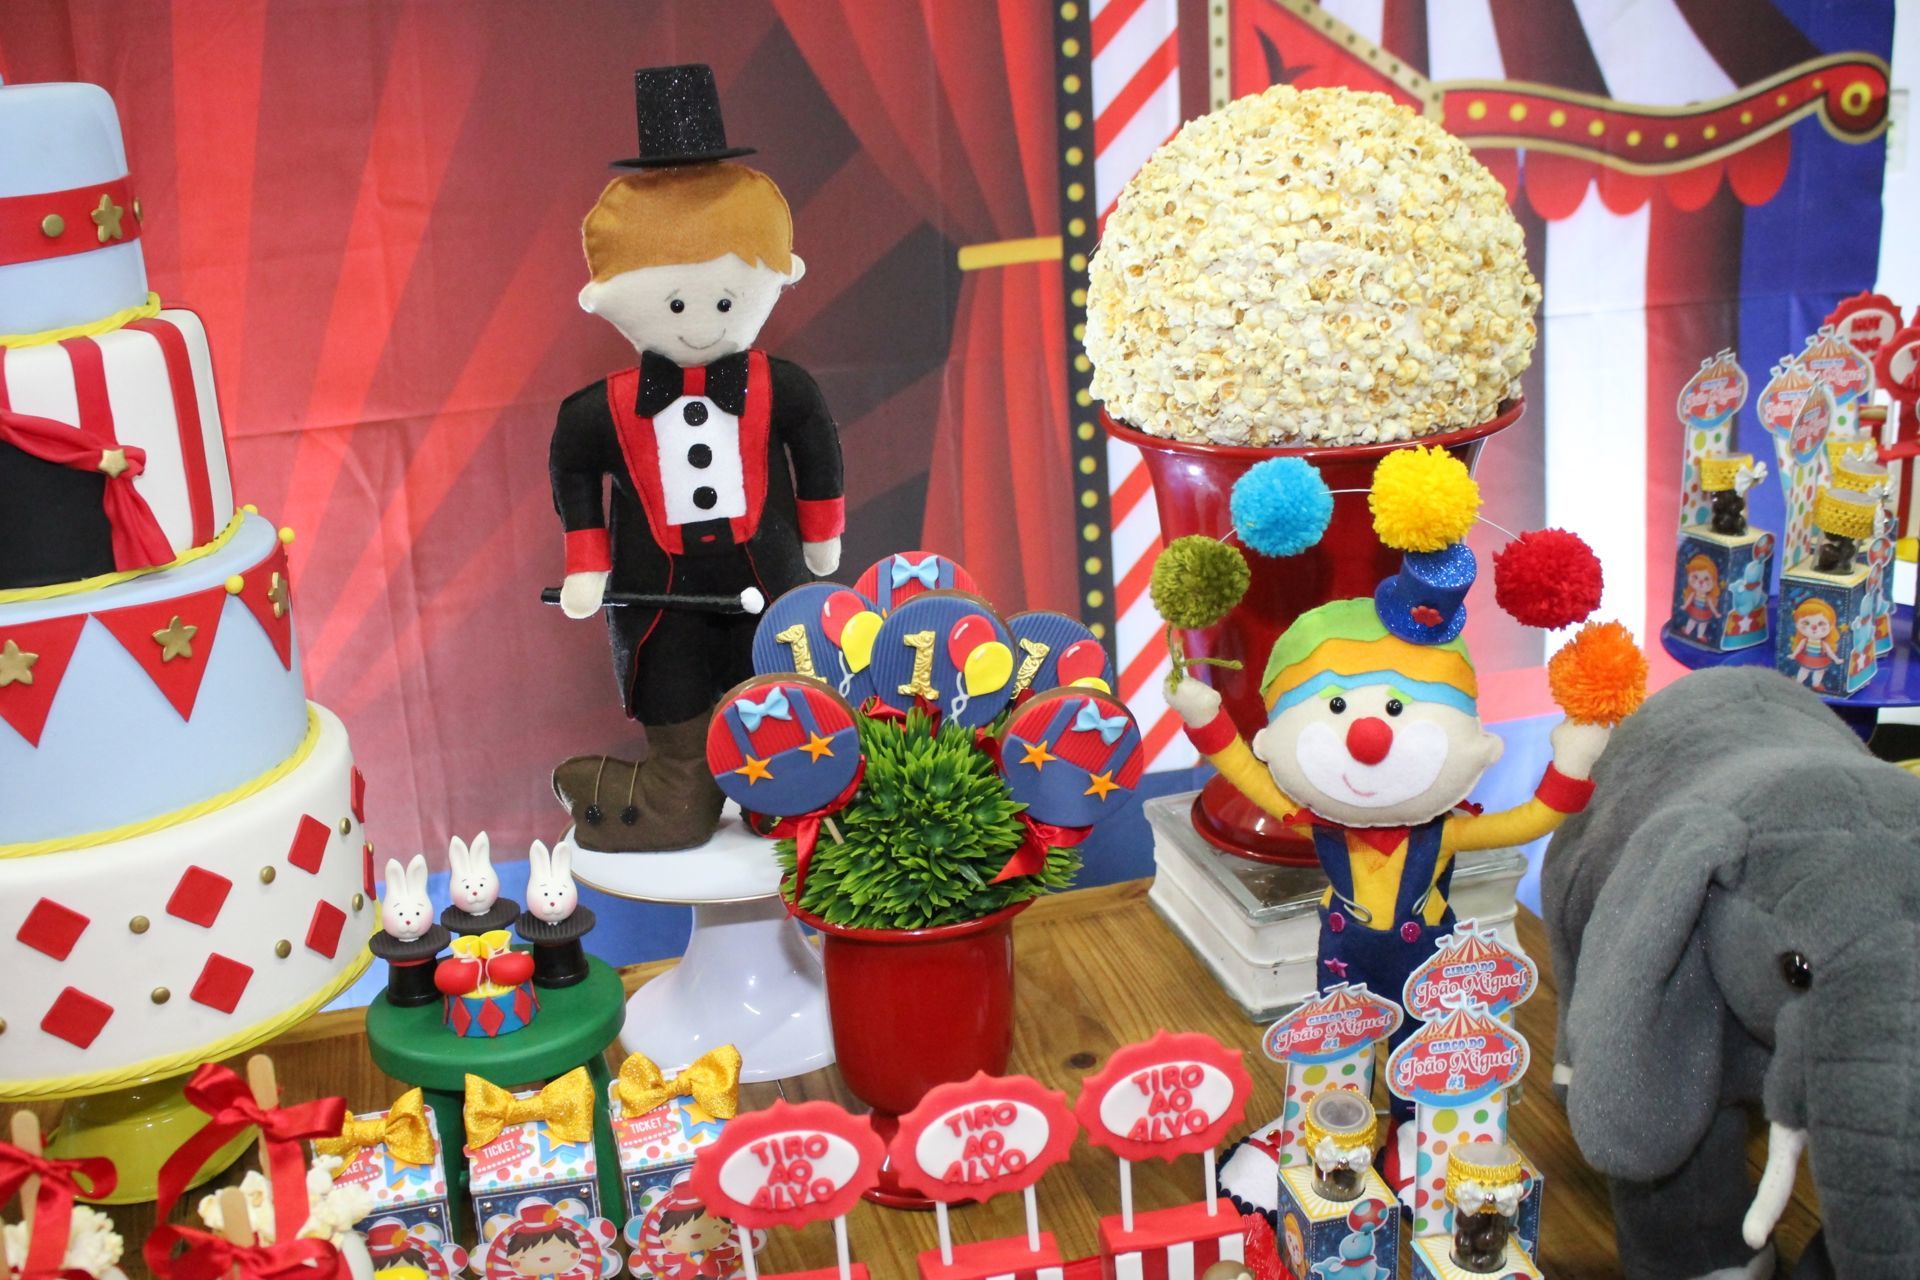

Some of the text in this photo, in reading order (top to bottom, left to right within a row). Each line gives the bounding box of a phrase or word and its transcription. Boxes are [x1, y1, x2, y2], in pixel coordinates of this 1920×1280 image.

[898, 630, 940, 700] 1
[1444, 961, 1496, 977] CIRCO DO
[1415, 968, 1527, 1008] João Miguel
[1275, 1013, 1392, 1051] João Miguel
[1131, 1064, 1205, 1096] TIRO
[1398, 1046, 1518, 1086] João Miguel
[1148, 1087, 1193, 1117] AO
[630, 1116, 662, 1135] TICKET
[944, 1102, 1018, 1138] TIRO
[1128, 1109, 1209, 1143] ALVO
[482, 1139, 516, 1159] TICKET
[750, 1134, 829, 1167] TIRO
[963, 1130, 1005, 1161] AO
[767, 1159, 813, 1186] AO
[943, 1149, 1027, 1186] ALVO
[750, 1178, 835, 1213] ALVO
